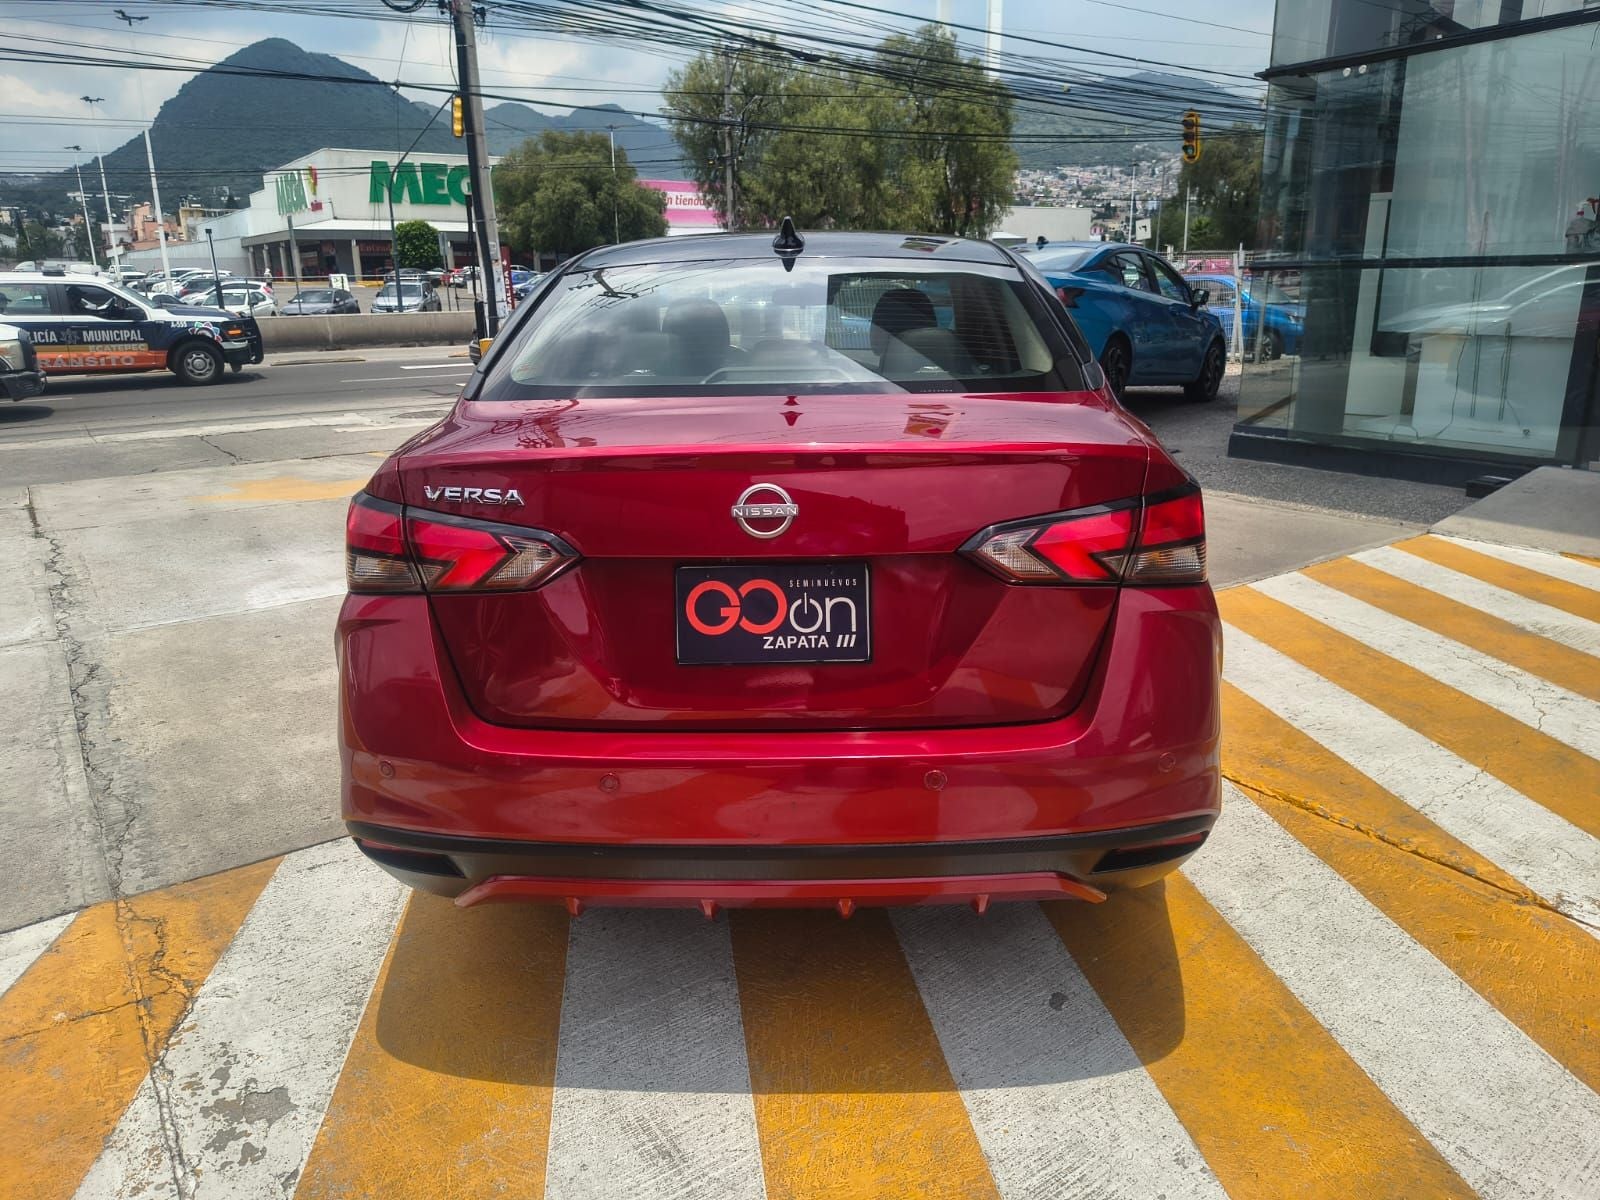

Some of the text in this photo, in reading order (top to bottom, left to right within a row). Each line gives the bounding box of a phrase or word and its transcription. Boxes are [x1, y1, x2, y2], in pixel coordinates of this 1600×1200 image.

[368, 160, 496, 206] MEG
[29, 329, 144, 344] LICÍA MUNICIPAL
[423, 485, 525, 506] VERSA
[733, 507, 797, 517] NISSAN
[789, 578, 857, 588] SEMINUEVOS
[763, 635, 829, 649] ZAPATA
